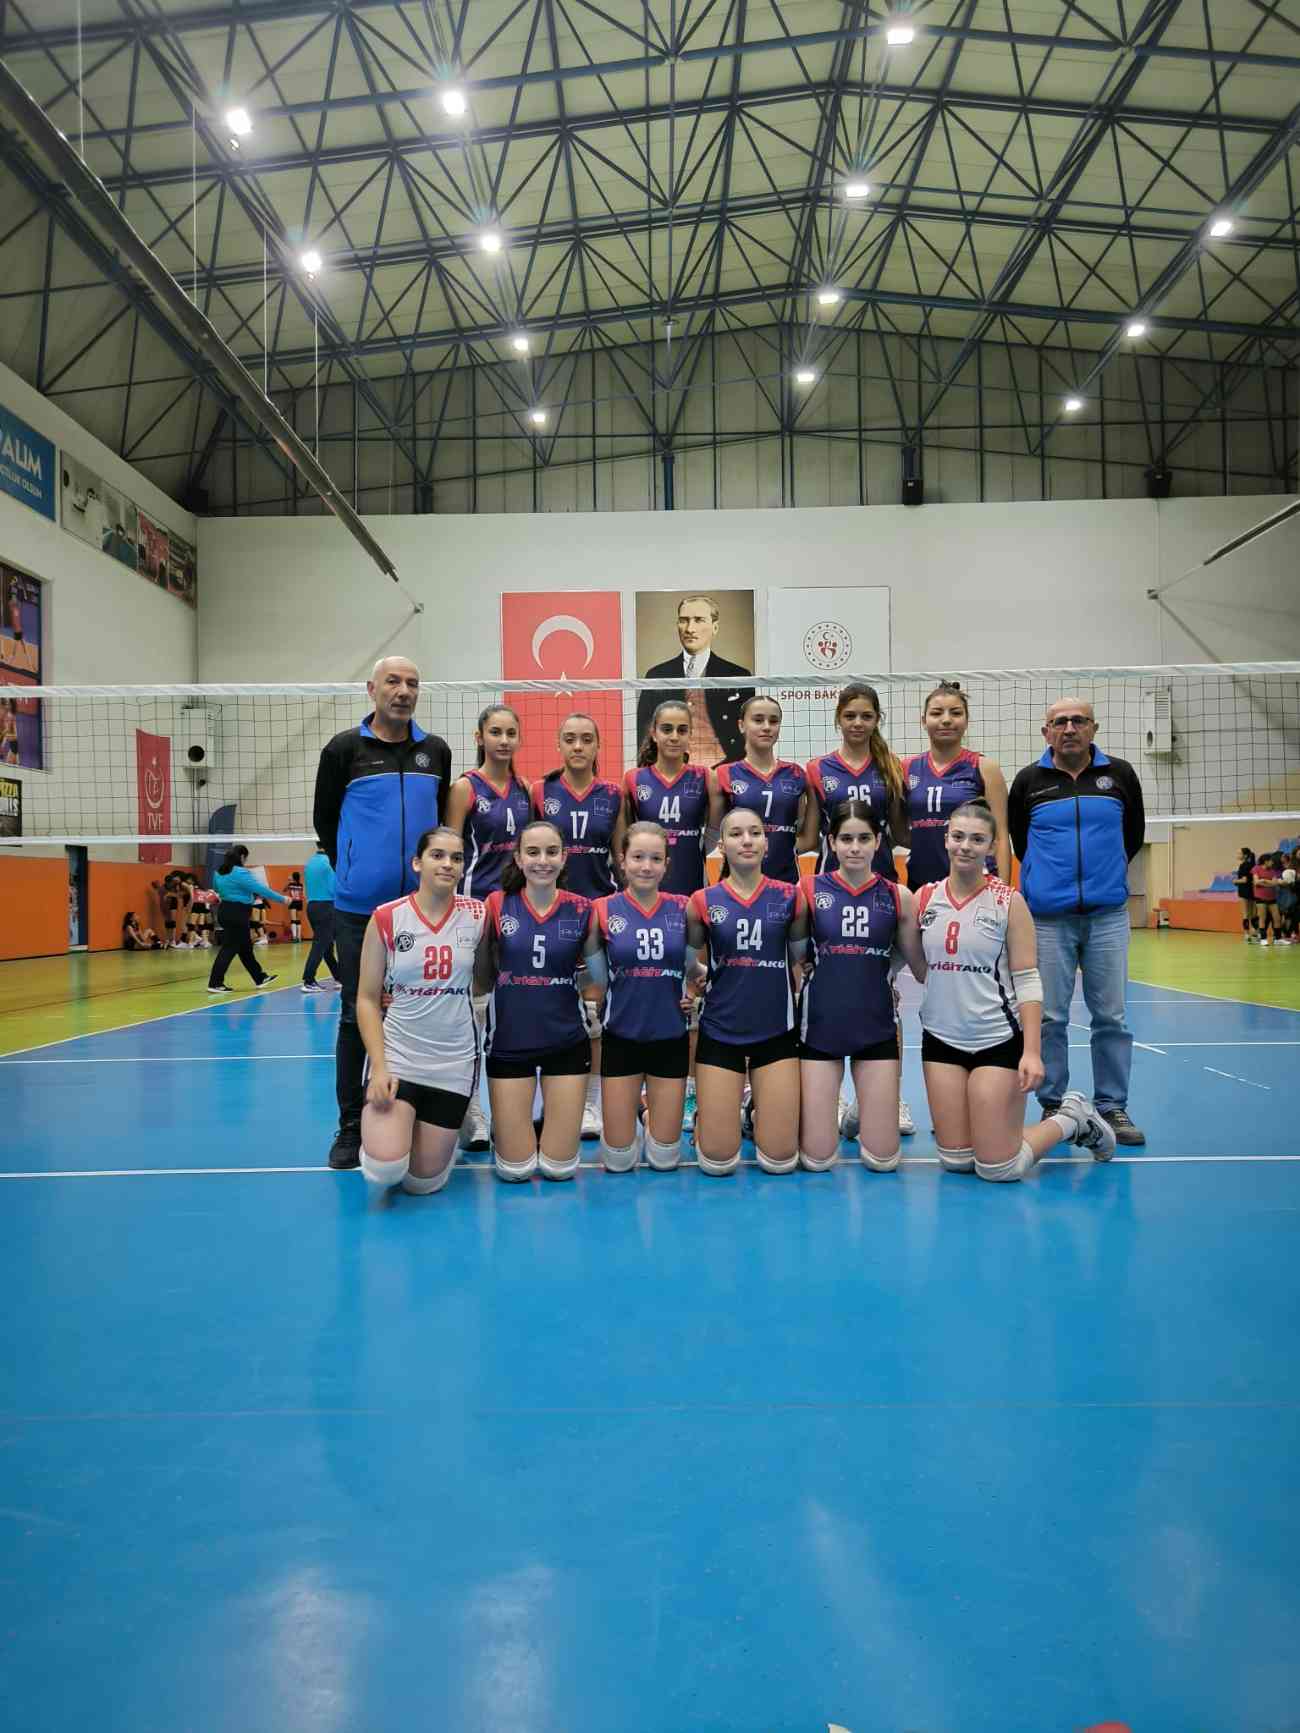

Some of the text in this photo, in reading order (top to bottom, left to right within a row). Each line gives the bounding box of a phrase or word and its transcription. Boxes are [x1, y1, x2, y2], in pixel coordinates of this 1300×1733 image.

[0, 430, 42, 480] ALIM
[780, 689, 840, 701] SPOR BAK
[658, 795, 681, 823] 44
[761, 790, 773, 818] 7
[927, 786, 943, 813] 11
[146, 812, 164, 831] TVF
[506, 807, 517, 836] 4
[570, 810, 589, 840] 17
[736, 918, 763, 951] 24
[841, 905, 870, 938] 22
[532, 933, 547, 969] 5
[636, 927, 665, 961] 33
[945, 921, 961, 955] 8
[423, 944, 453, 980] 28
